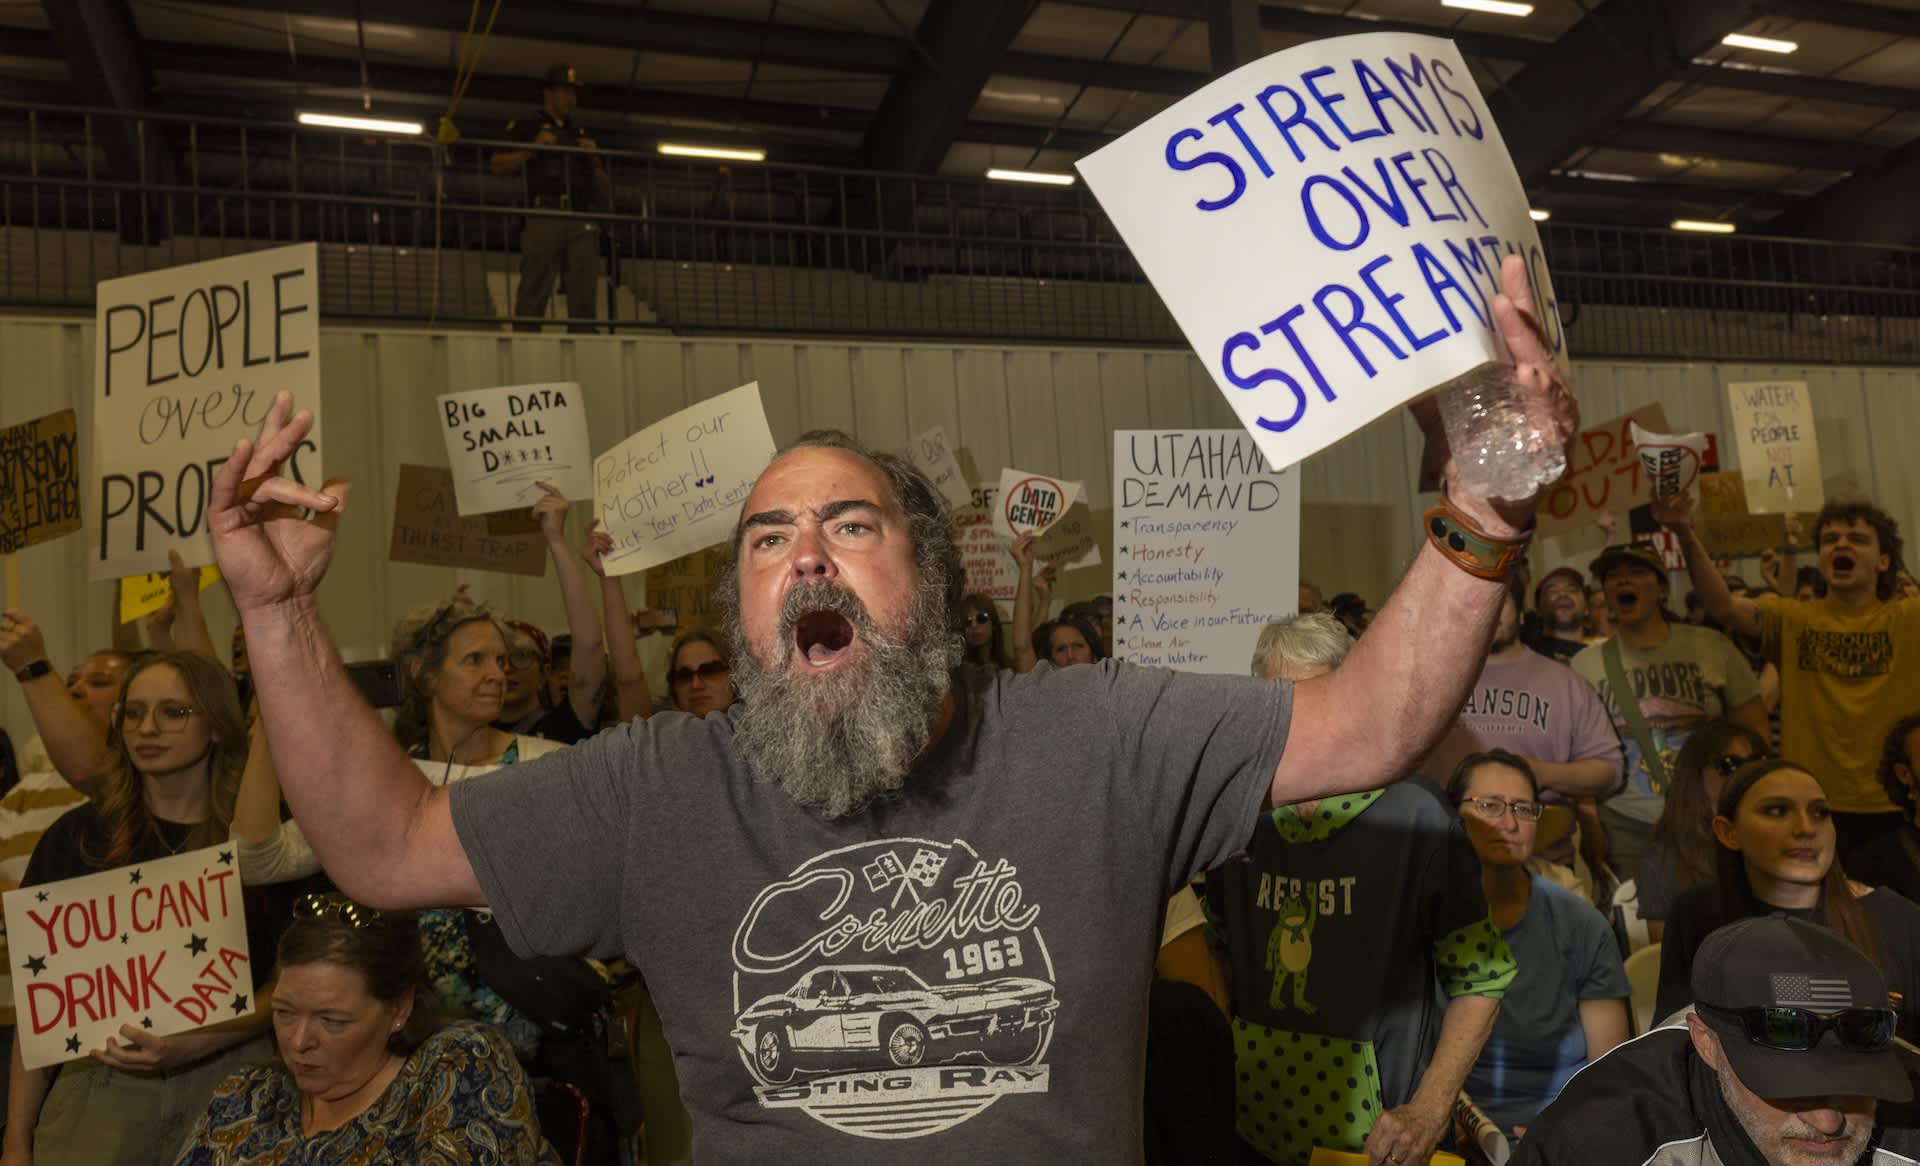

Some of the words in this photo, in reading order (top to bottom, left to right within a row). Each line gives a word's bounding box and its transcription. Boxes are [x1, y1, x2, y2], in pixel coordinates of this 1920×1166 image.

[1164, 53, 1484, 212] STREAMS
[1300, 147, 1489, 251] OVER
[105, 268, 310, 397] PEOPLE
[445, 400, 486, 429] BIG
[509, 390, 567, 416] DATA
[1744, 386, 1798, 408] WATER
[139, 384, 271, 446] over
[463, 420, 545, 452] SMALL
[1751, 424, 1800, 443] PEOPLE
[597, 432, 669, 496] Protect
[686, 410, 732, 442] our
[1130, 433, 1287, 480] UTAHAN
[1551, 460, 1640, 520] OUT
[1768, 464, 1797, 488] AI
[100, 440, 317, 561] PROFS
[1020, 486, 1056, 511] DATA
[1122, 478, 1280, 512] DEMAND
[610, 528, 644, 552] uck
[1130, 517, 1238, 536] Transparency
[477, 538, 529, 560] TRAP
[1132, 544, 1205, 564] Honesty
[1130, 568, 1224, 589] Accountability
[1128, 589, 1220, 616] Responsibility
[1129, 614, 1144, 632] A
[1152, 610, 1189, 631] Voice
[1167, 651, 1208, 665] Water
[26, 895, 116, 956] YOU
[131, 867, 234, 934] CAN'T
[732, 858, 1040, 974] Corvette
[944, 936, 1023, 979] 1963
[26, 950, 172, 1035] DRINK
[174, 947, 248, 1025] DATA
[759, 1073, 912, 1100] STING
[940, 1068, 1044, 1090] RAY
